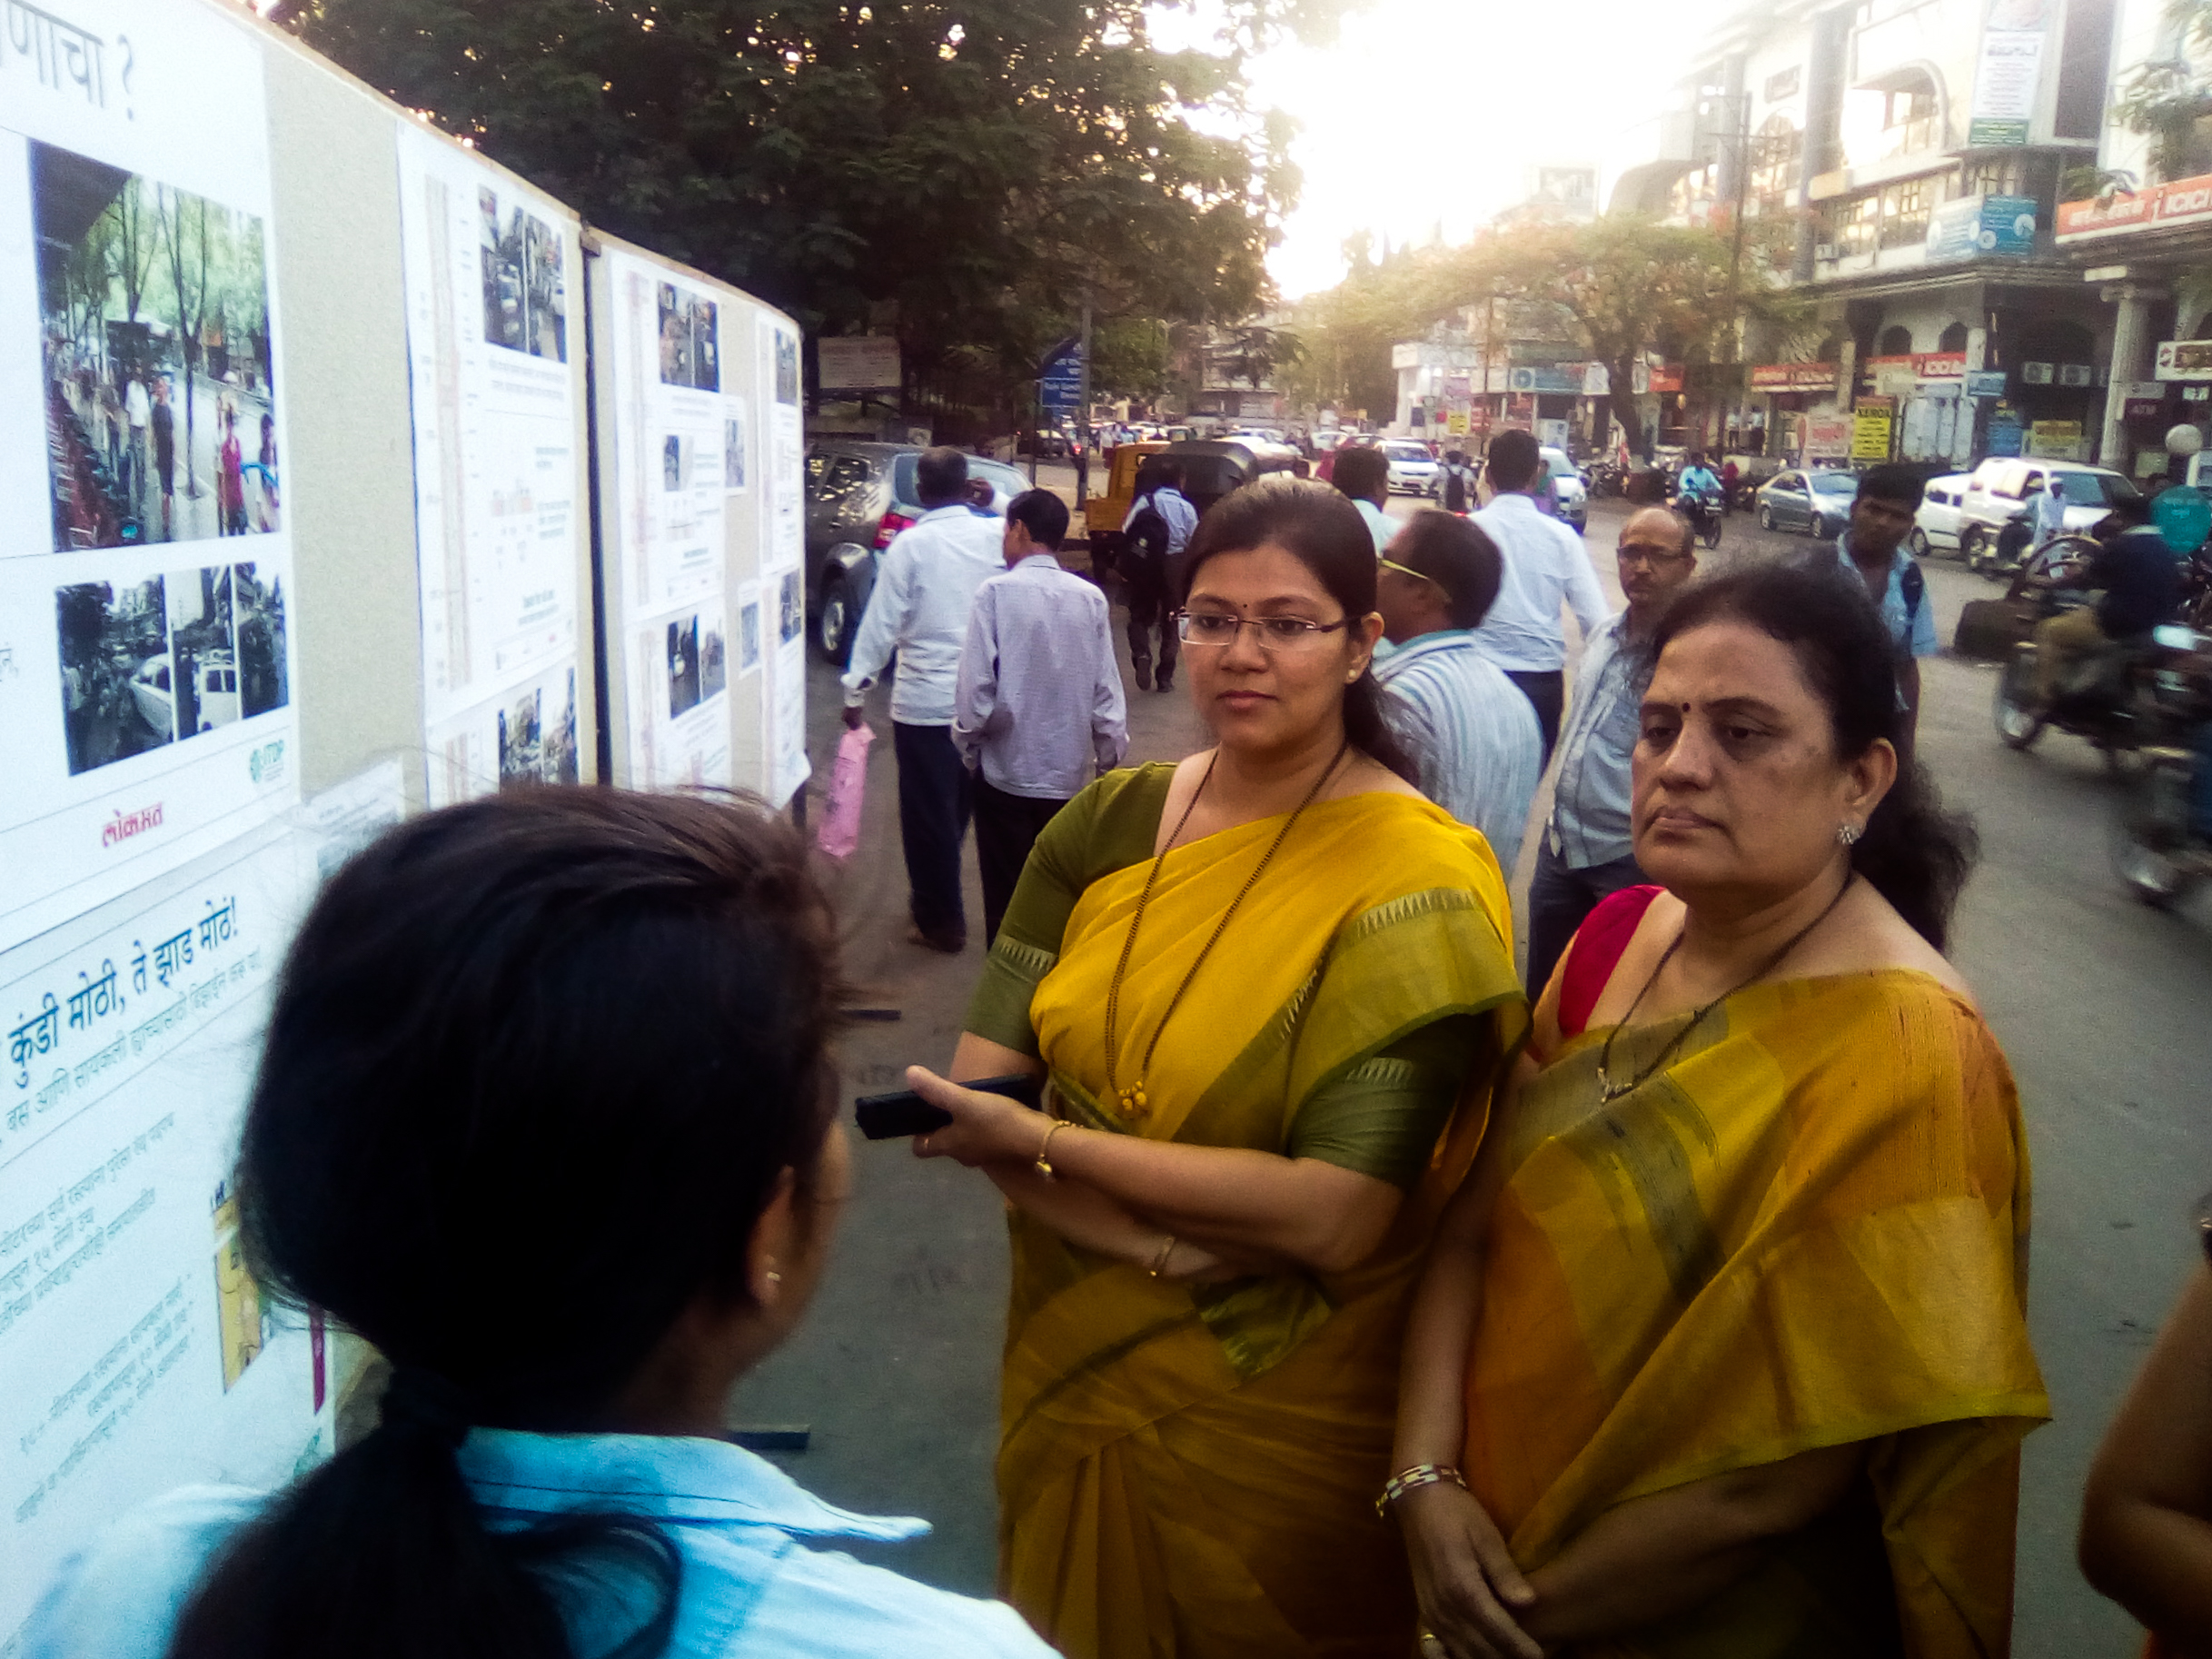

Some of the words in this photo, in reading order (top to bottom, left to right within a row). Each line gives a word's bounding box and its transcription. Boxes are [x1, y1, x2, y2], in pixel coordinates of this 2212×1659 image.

[102, 800, 163, 848] लोकमत
[7, 991, 59, 1089] कुंडी
[67, 958, 125, 1030] मोठी,
[131, 939, 147, 995] ते
[153, 928, 193, 988] झाड
